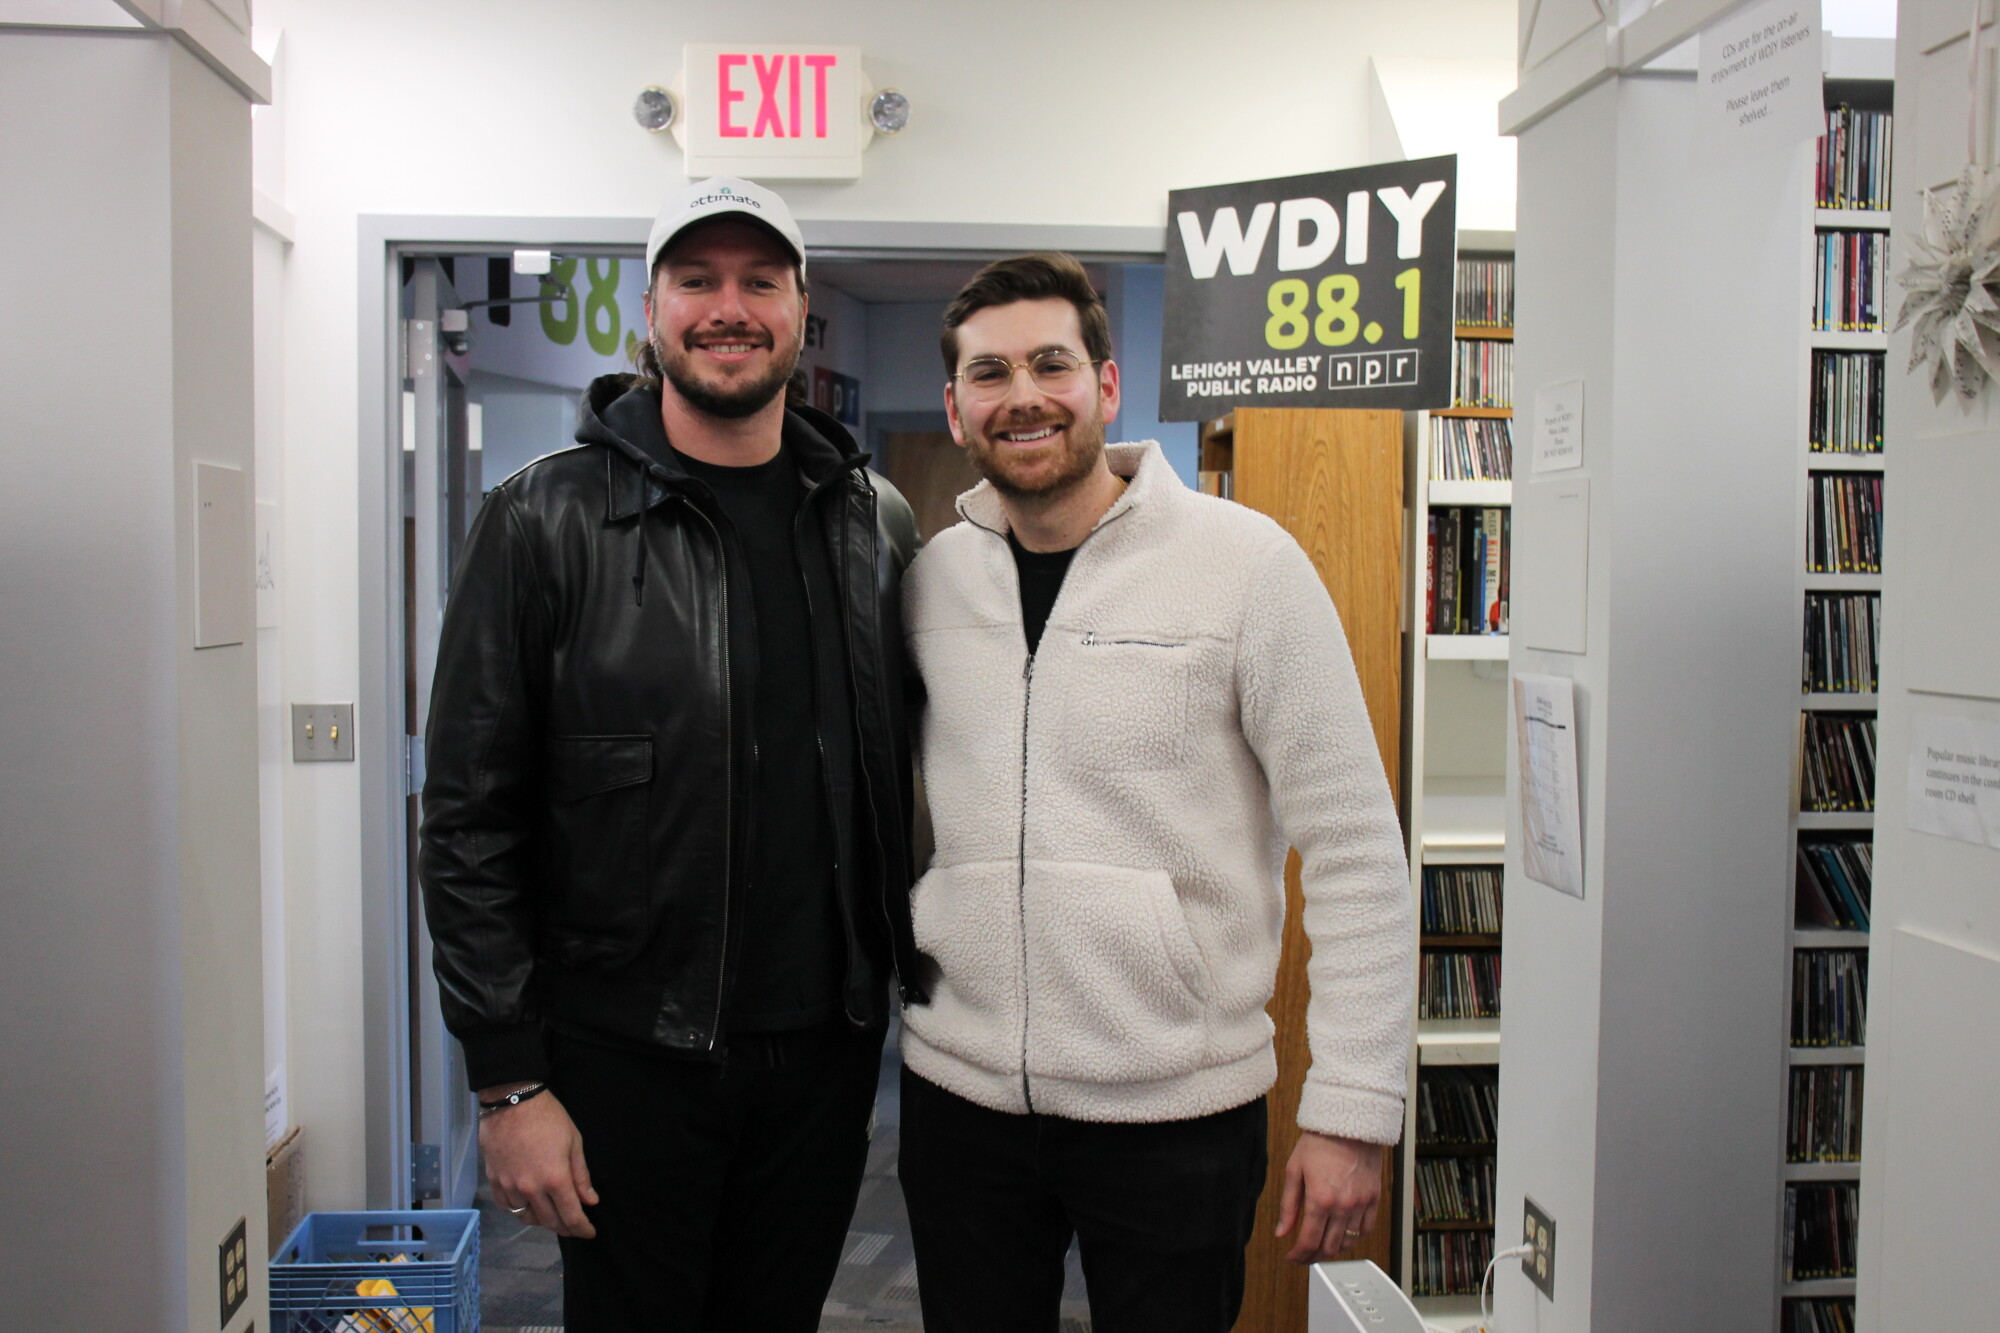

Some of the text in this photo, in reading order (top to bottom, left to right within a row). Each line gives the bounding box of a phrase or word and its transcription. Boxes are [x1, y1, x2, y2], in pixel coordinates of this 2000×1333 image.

[1738, 38, 1750, 52] are
[1752, 31, 1762, 44] for
[1763, 24, 1776, 39] the
[1710, 26, 1810, 83] enjoyment of WDIY listeners
[718, 54, 836, 138] EXIT
[1726, 76, 1790, 112] Please leave them
[690, 194, 761, 209] ottimate
[1177, 180, 1447, 279] WDIY
[1265, 268, 1421, 350] 88.1
[1171, 355, 1321, 381] LEHIGH VALLEY
[1335, 356, 1408, 386] npr
[1186, 374, 1317, 398] PUBLIC RADIO
[1927, 747, 1953, 762] Popular
[1956, 753, 1976, 765] music
[1926, 768, 1960, 783] continues
[1970, 774, 1981, 786] the
[1945, 789, 1956, 801] CD
